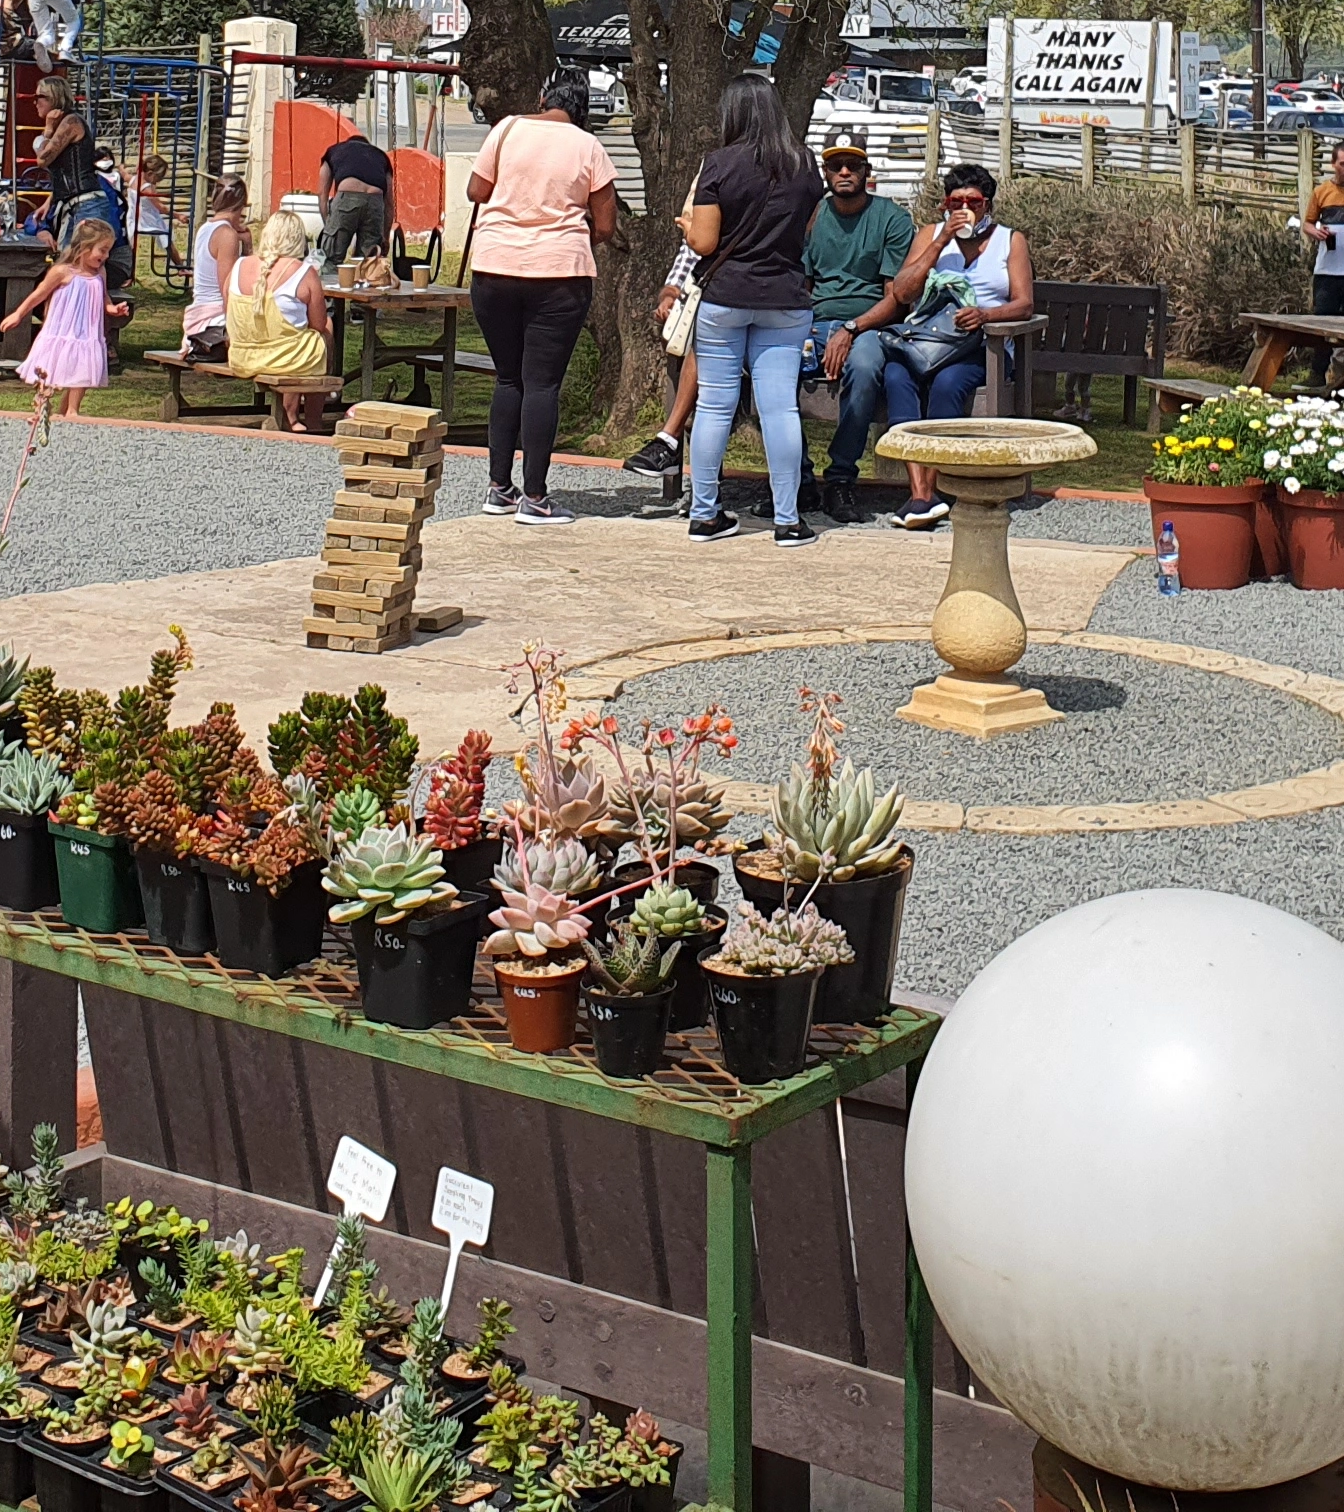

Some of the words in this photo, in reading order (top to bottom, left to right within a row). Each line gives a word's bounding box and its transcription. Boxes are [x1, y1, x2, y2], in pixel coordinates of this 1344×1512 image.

[1046, 31, 1116, 48] MANY
[1035, 53, 1124, 70] THANKS
[1014, 75, 1063, 92] CALL
[1069, 76, 1143, 94] AGAIN
